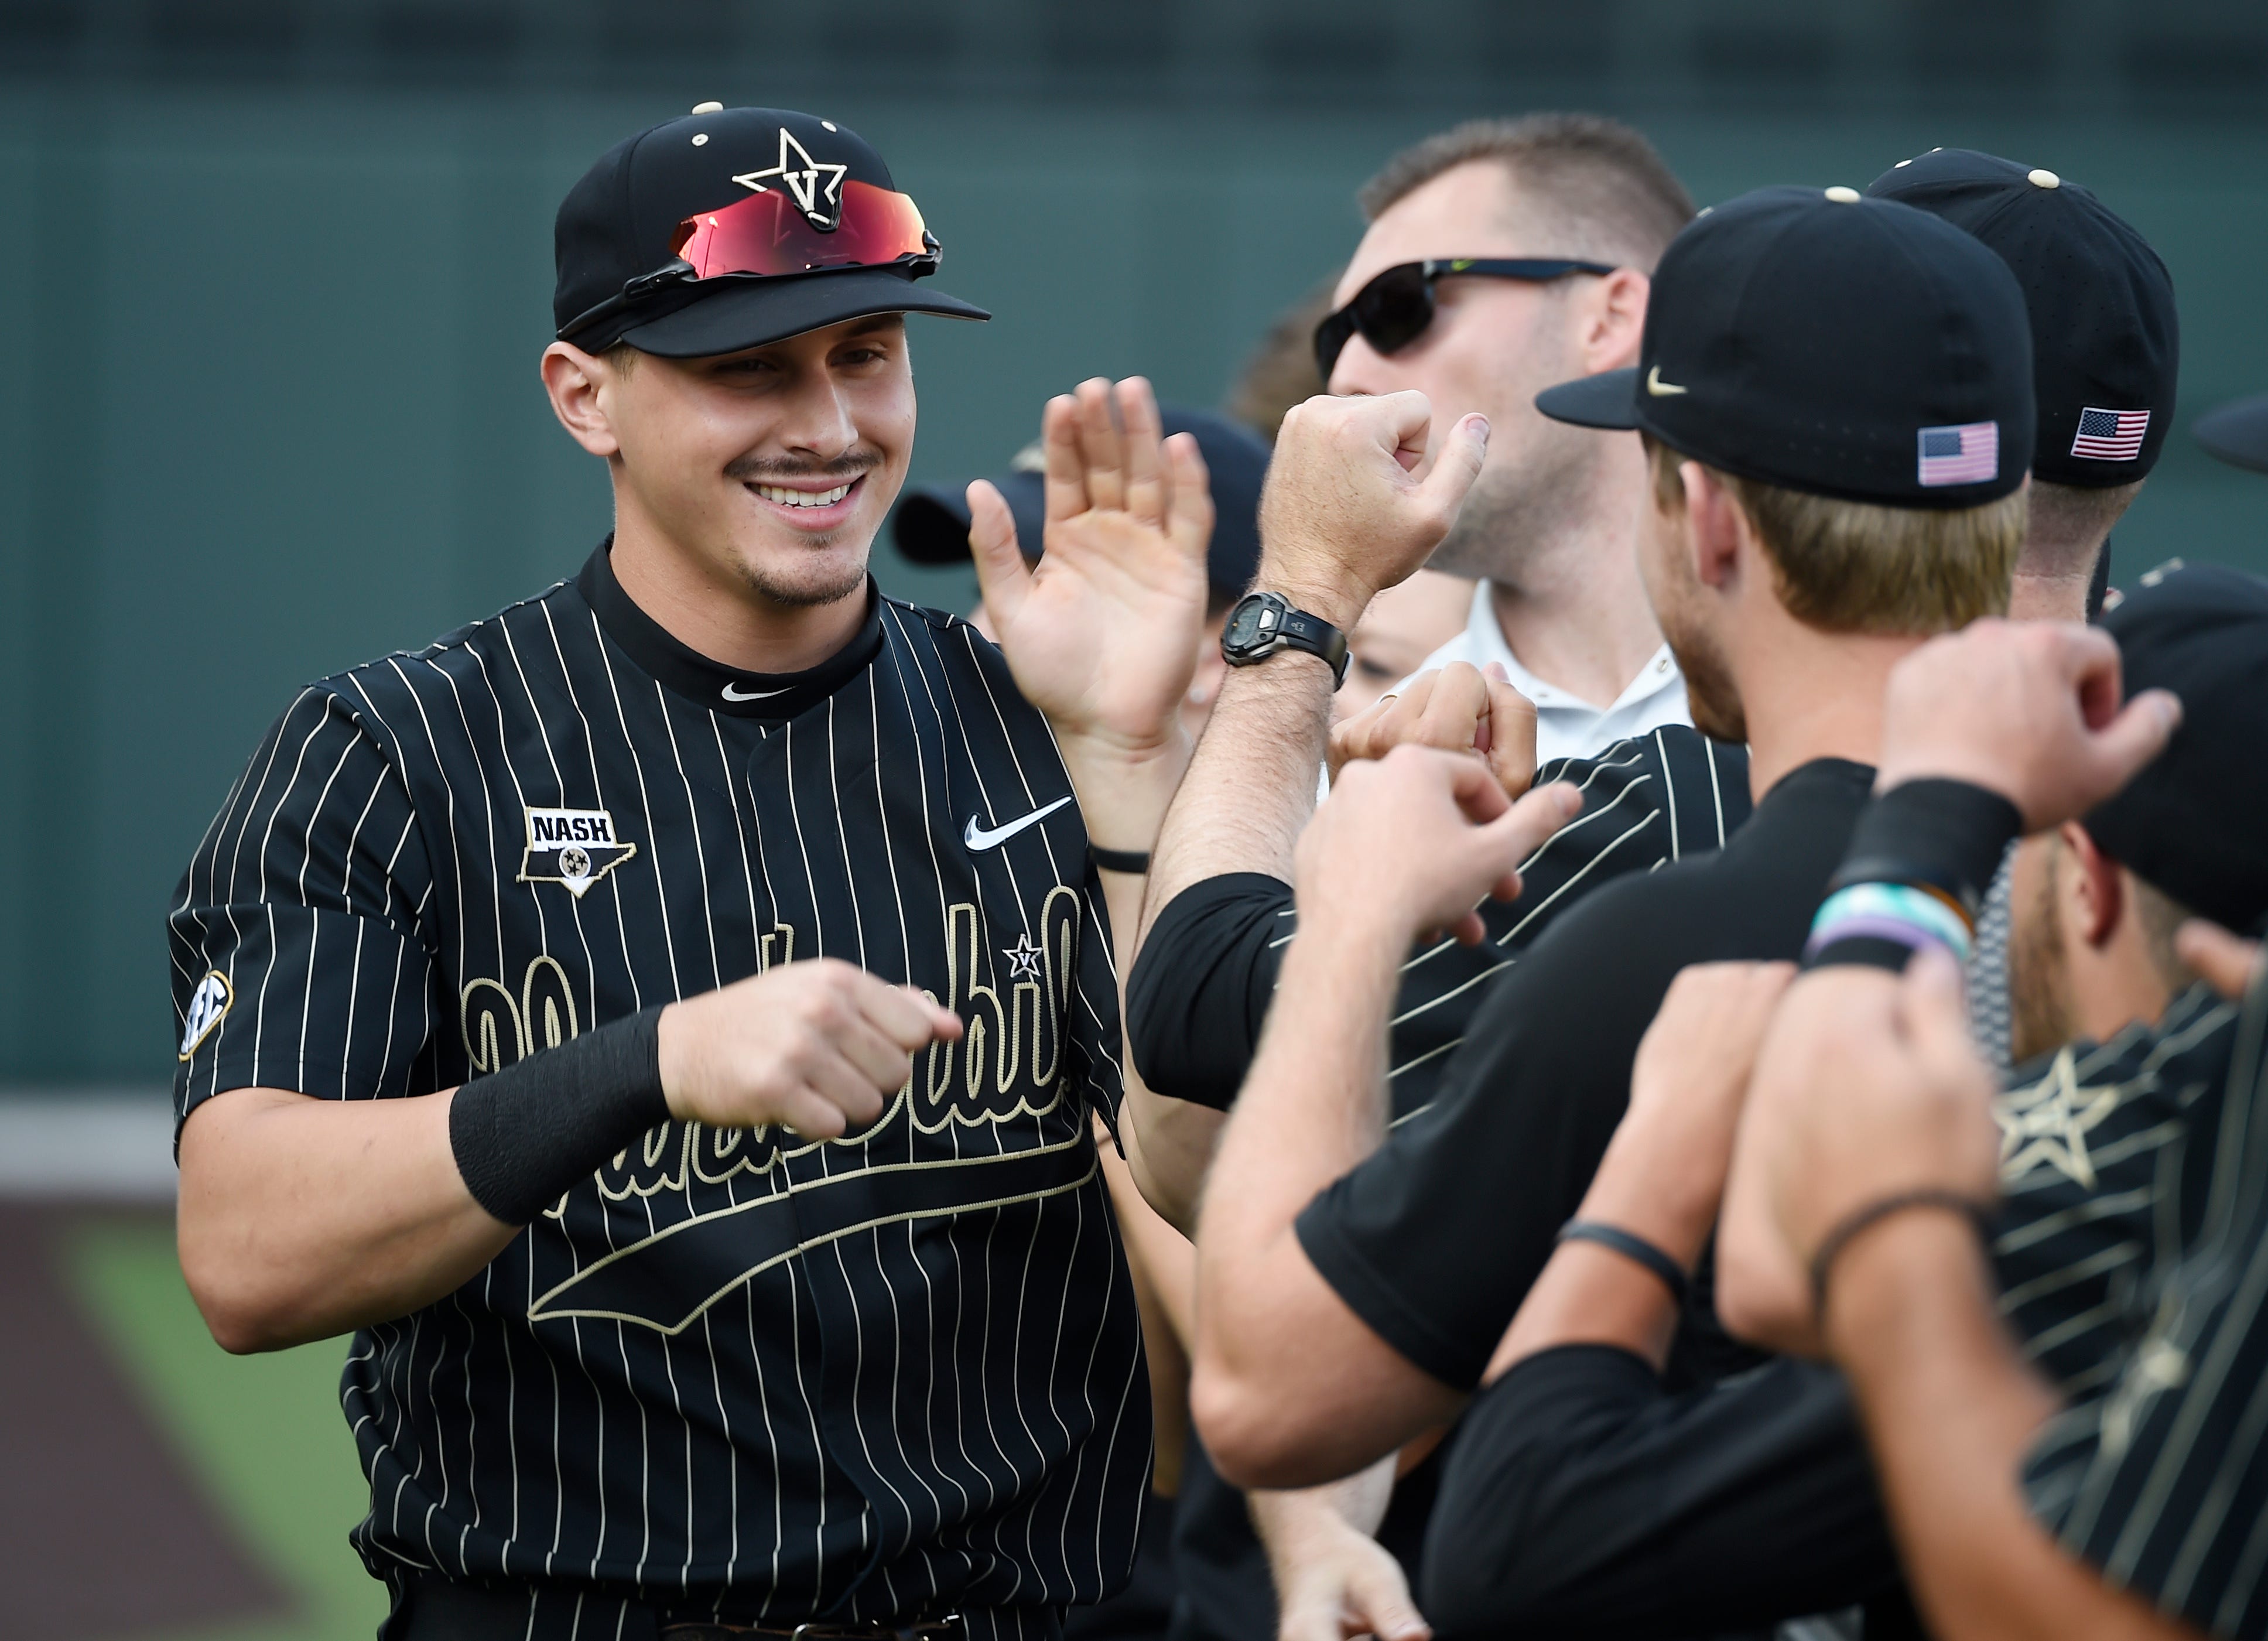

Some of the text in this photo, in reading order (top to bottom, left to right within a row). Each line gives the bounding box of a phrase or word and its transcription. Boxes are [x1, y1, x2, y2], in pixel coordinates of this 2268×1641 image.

[782, 169, 819, 212] V
[532, 816, 611, 842] NASH
[1017, 952, 1031, 967] V
